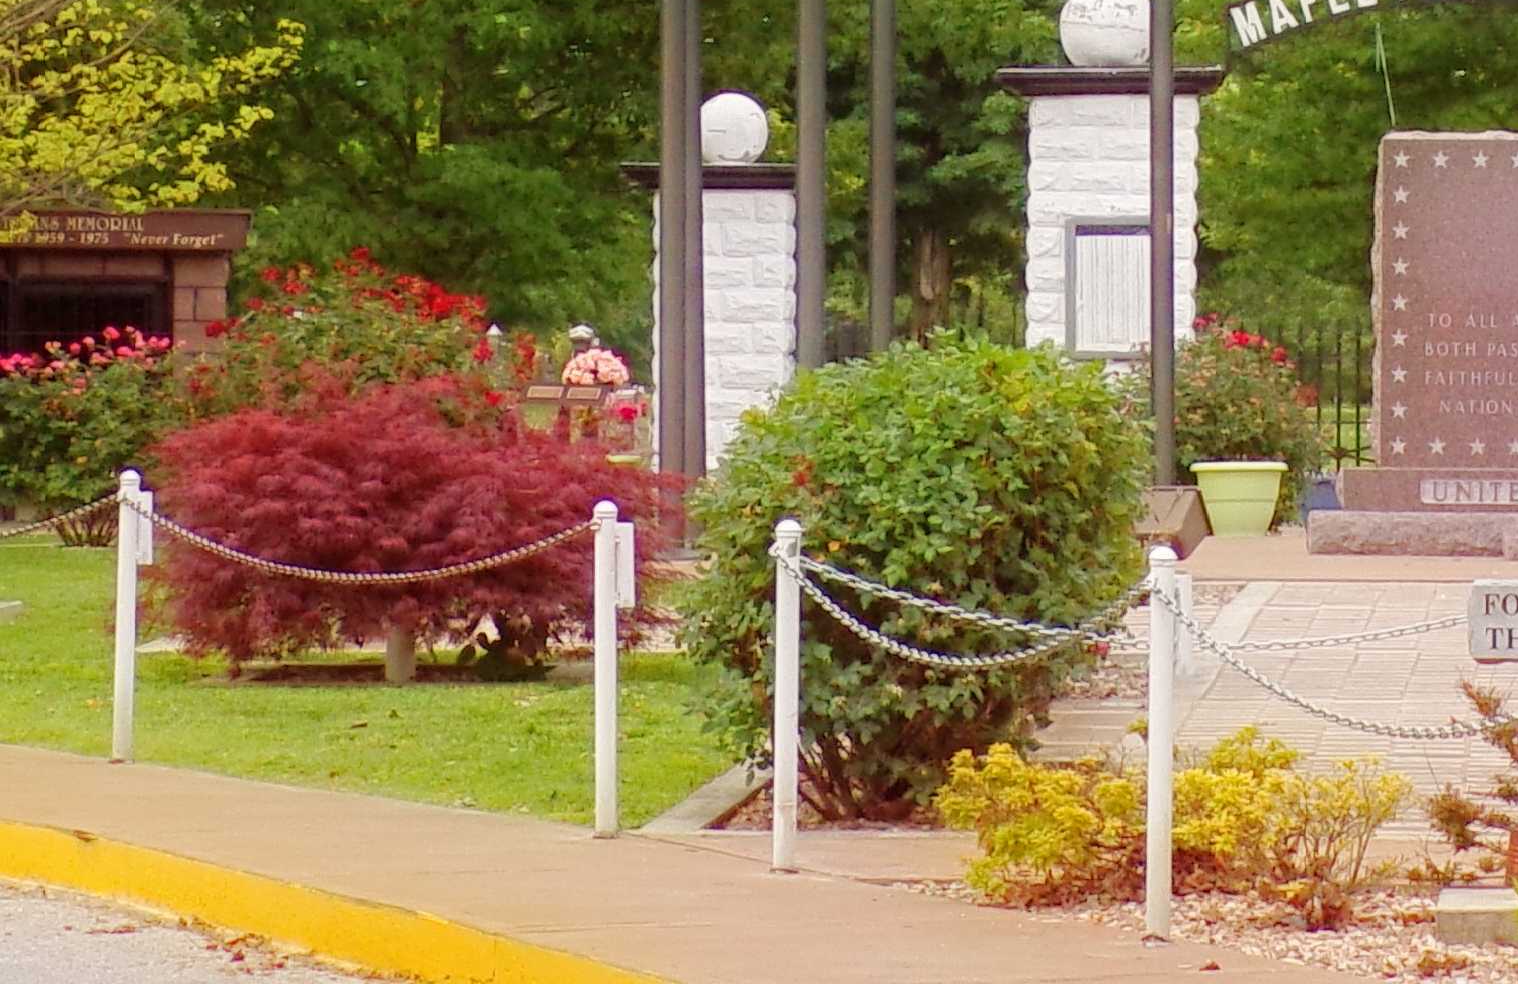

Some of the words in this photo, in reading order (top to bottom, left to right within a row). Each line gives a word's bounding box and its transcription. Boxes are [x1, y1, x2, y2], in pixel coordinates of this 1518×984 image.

[67, 217, 144, 231] MEMORIAL
[80, 232, 109, 245] 1975
[1428, 313, 1451, 328] TO
[1465, 314, 1498, 328] ALL
[1424, 342, 1477, 357] BOTH
[1440, 399, 1512, 415] NATION
